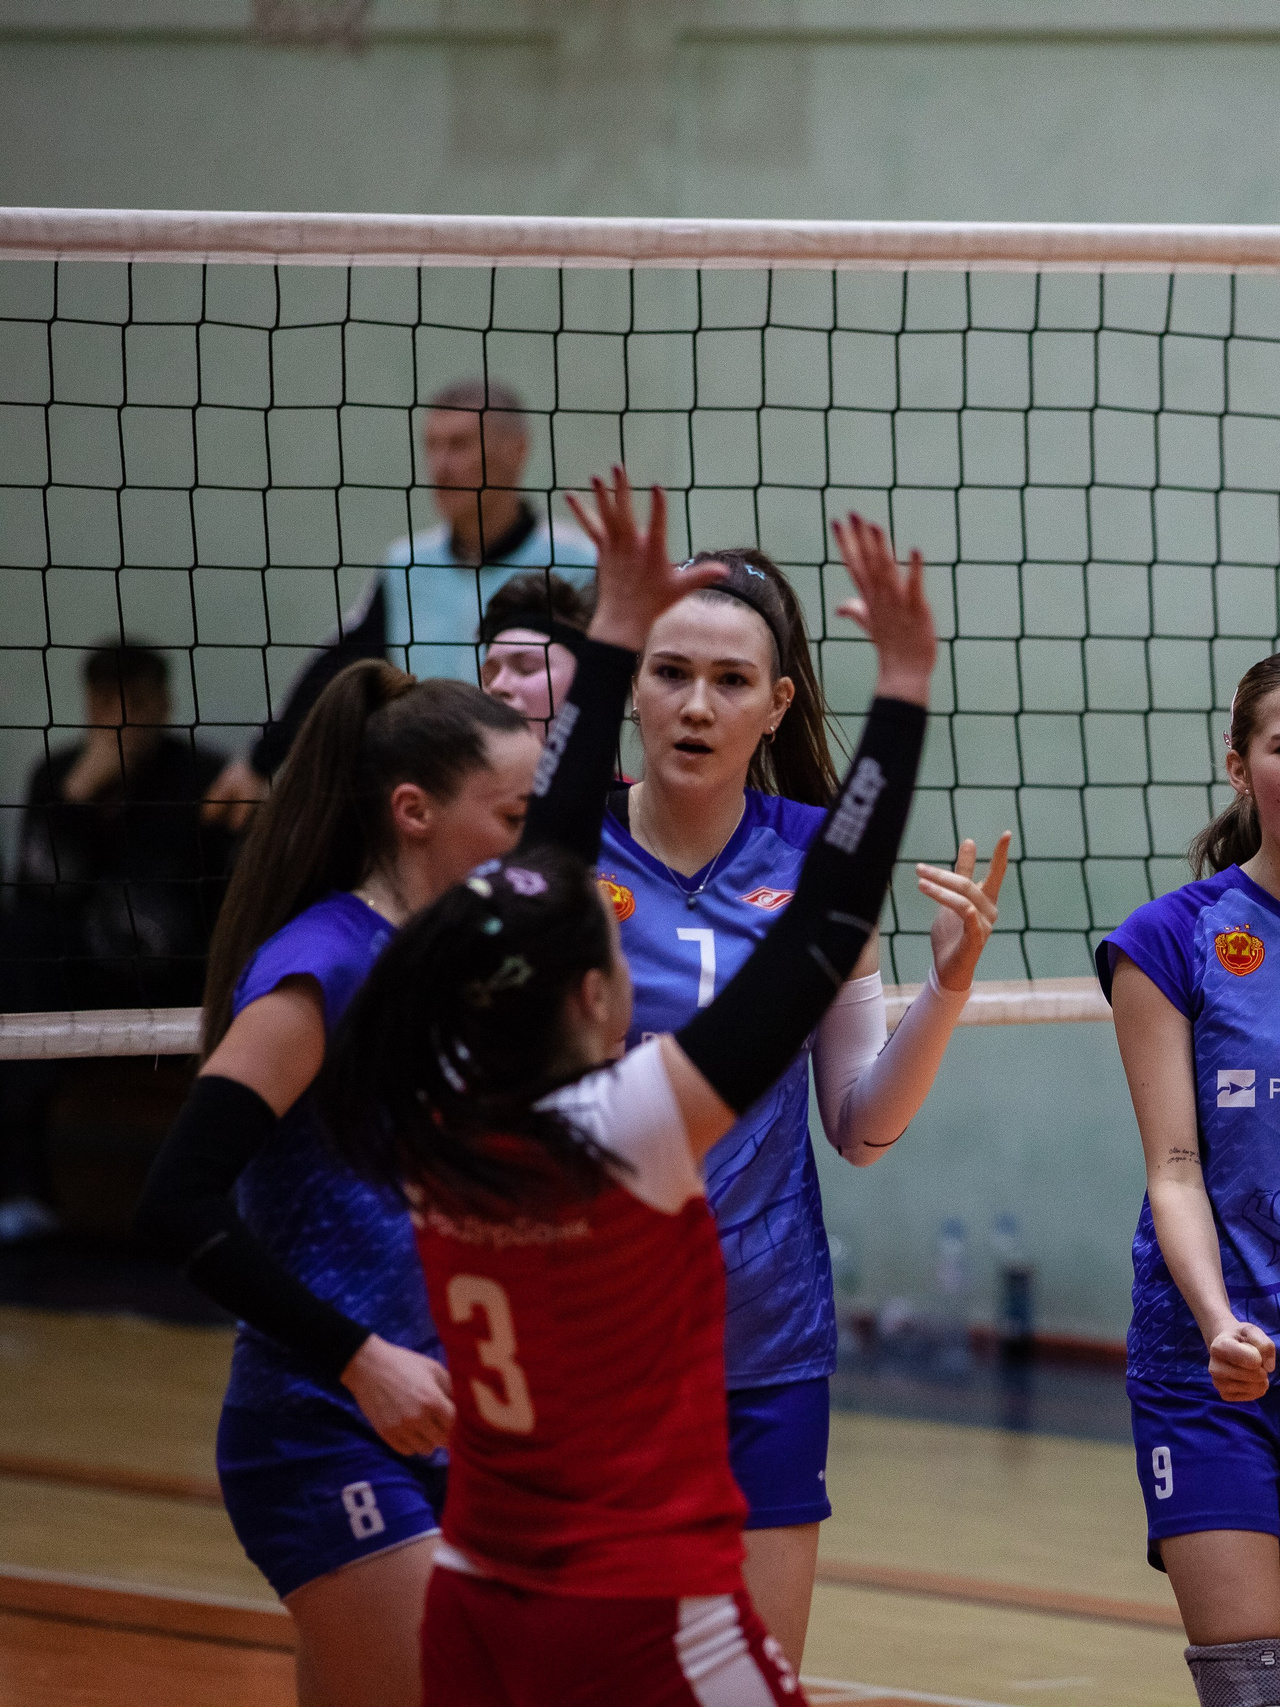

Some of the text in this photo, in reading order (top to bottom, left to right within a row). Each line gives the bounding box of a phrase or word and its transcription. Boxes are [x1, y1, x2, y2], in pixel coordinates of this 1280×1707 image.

[676, 927, 717, 1008] 7
[446, 1273, 537, 1435] 3
[1151, 1445, 1174, 1500] 9
[341, 1480, 386, 1540] 8
